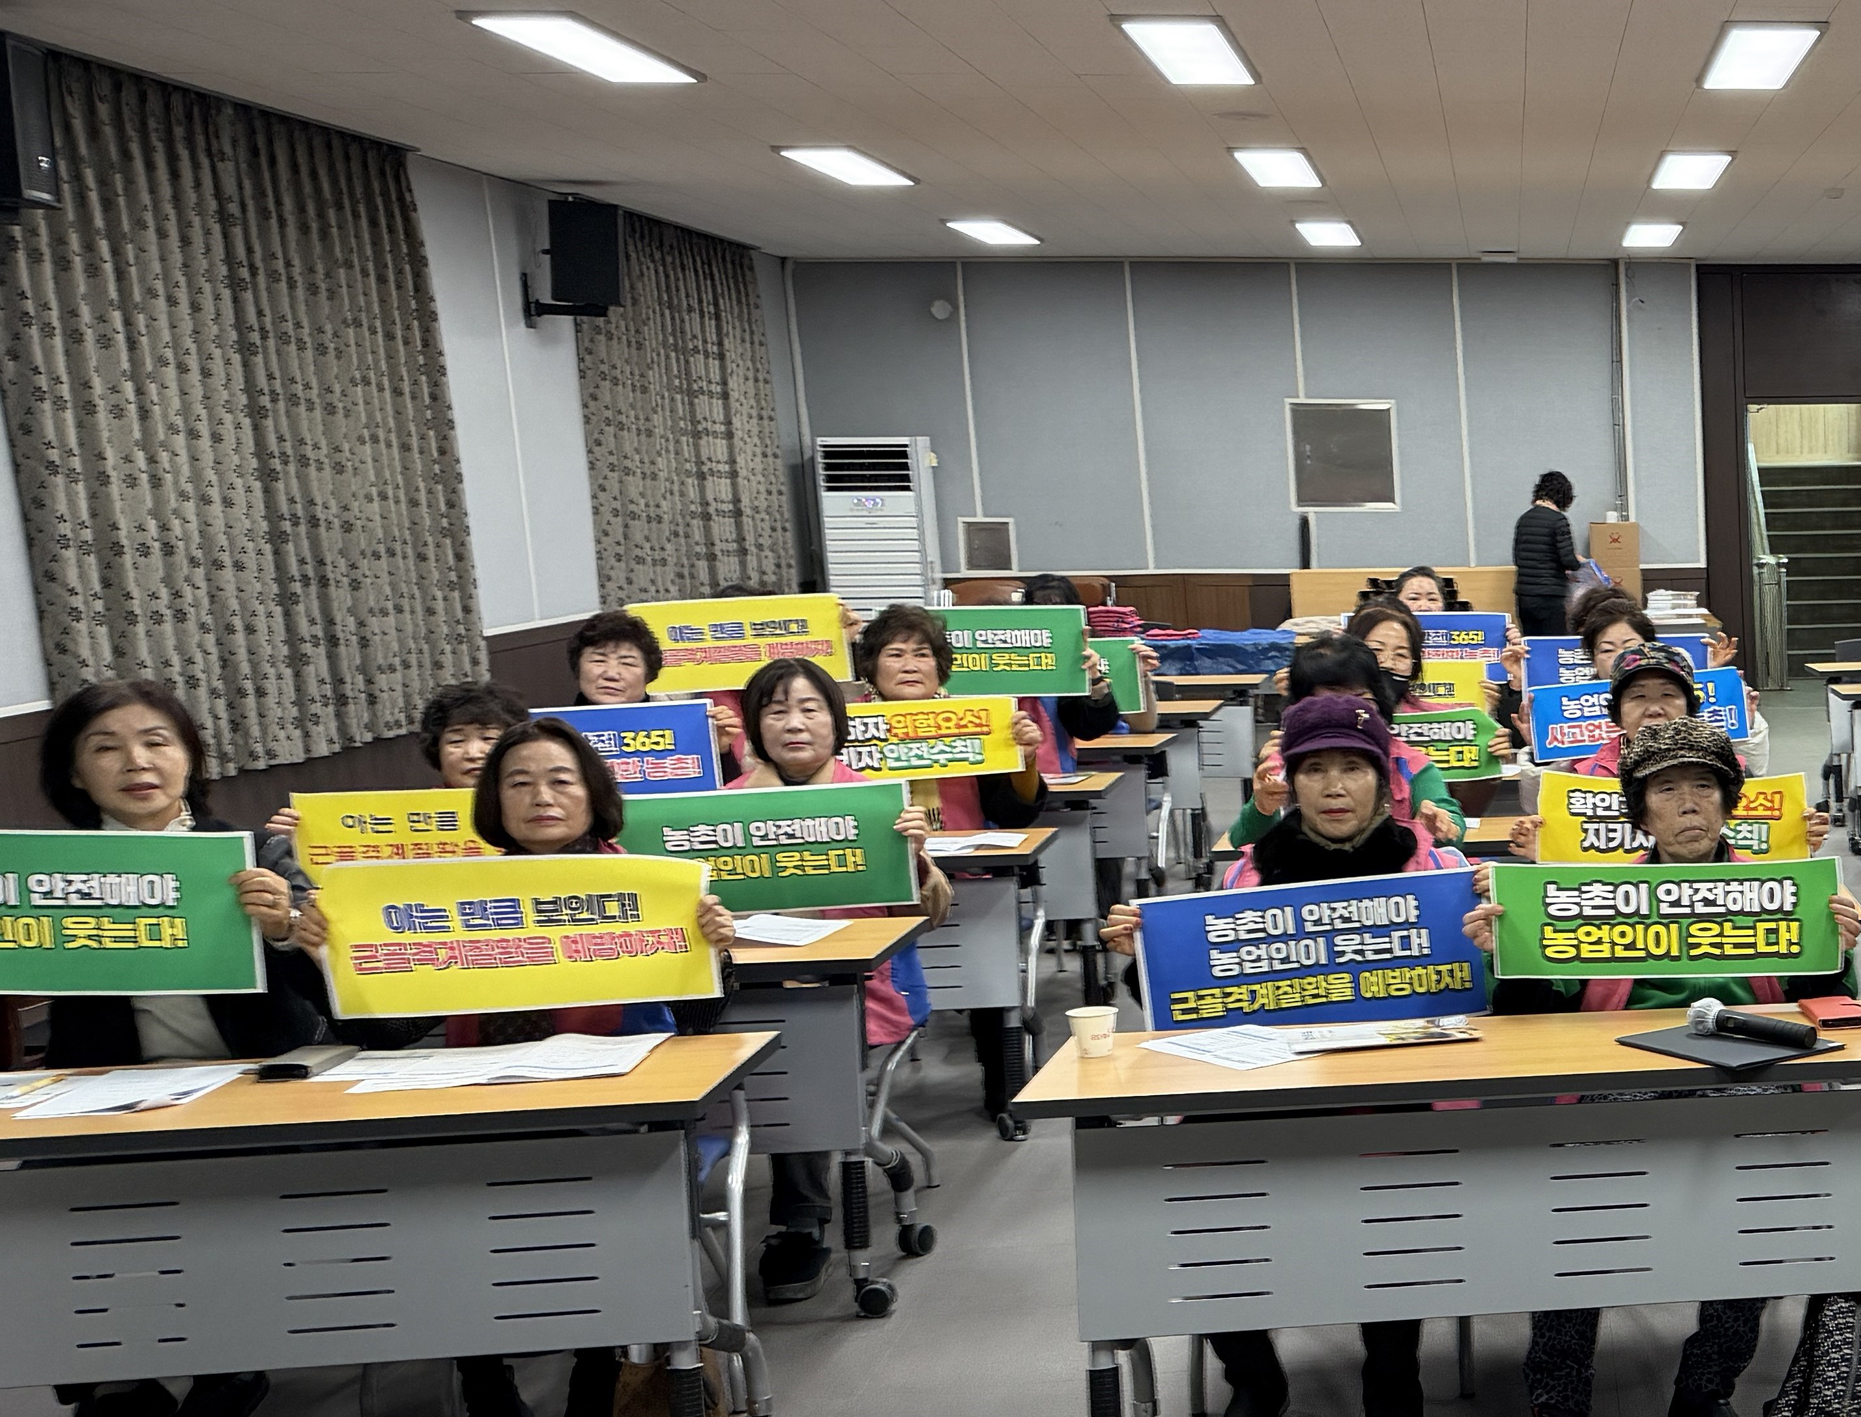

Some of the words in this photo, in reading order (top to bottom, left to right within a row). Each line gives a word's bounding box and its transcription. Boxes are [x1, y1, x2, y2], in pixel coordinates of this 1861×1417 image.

[974, 628, 1053, 648] 안전해야
[1450, 631, 1485, 644] 365!
[991, 652, 1056, 671] 웃는다!
[888, 709, 992, 737] 위험요소!
[620, 729, 676, 753] 365!
[883, 738, 985, 769] 안전수칙!
[1413, 745, 1480, 768] 는다!
[341, 813, 396, 834] 아는
[662, 822, 746, 851] 농촌이
[749, 815, 859, 846] 안전해야
[776, 848, 867, 876] 웃는다!
[27, 872, 182, 907] 안전해야
[1545, 881, 1650, 917] 농촌이
[1656, 878, 1797, 915] 안전해야
[382, 902, 454, 933] 아는
[455, 897, 527, 931] 만큼
[532, 891, 643, 927] 보인다!
[1204, 906, 1296, 943] 농촌이
[1301, 894, 1420, 933] 안전해야
[61, 915, 190, 949] 웃는다!
[1542, 923, 1680, 959] 농업인이
[1687, 921, 1801, 956] 웃는다!
[349, 936, 559, 975] 근골격계질환을
[560, 927, 692, 962] 예방하자!
[1208, 936, 1329, 977] 농업인이
[1333, 928, 1432, 963] 웃는다!
[1169, 972, 1356, 1022] 근골격계질환을
[1358, 962, 1474, 998] 예방하자!
